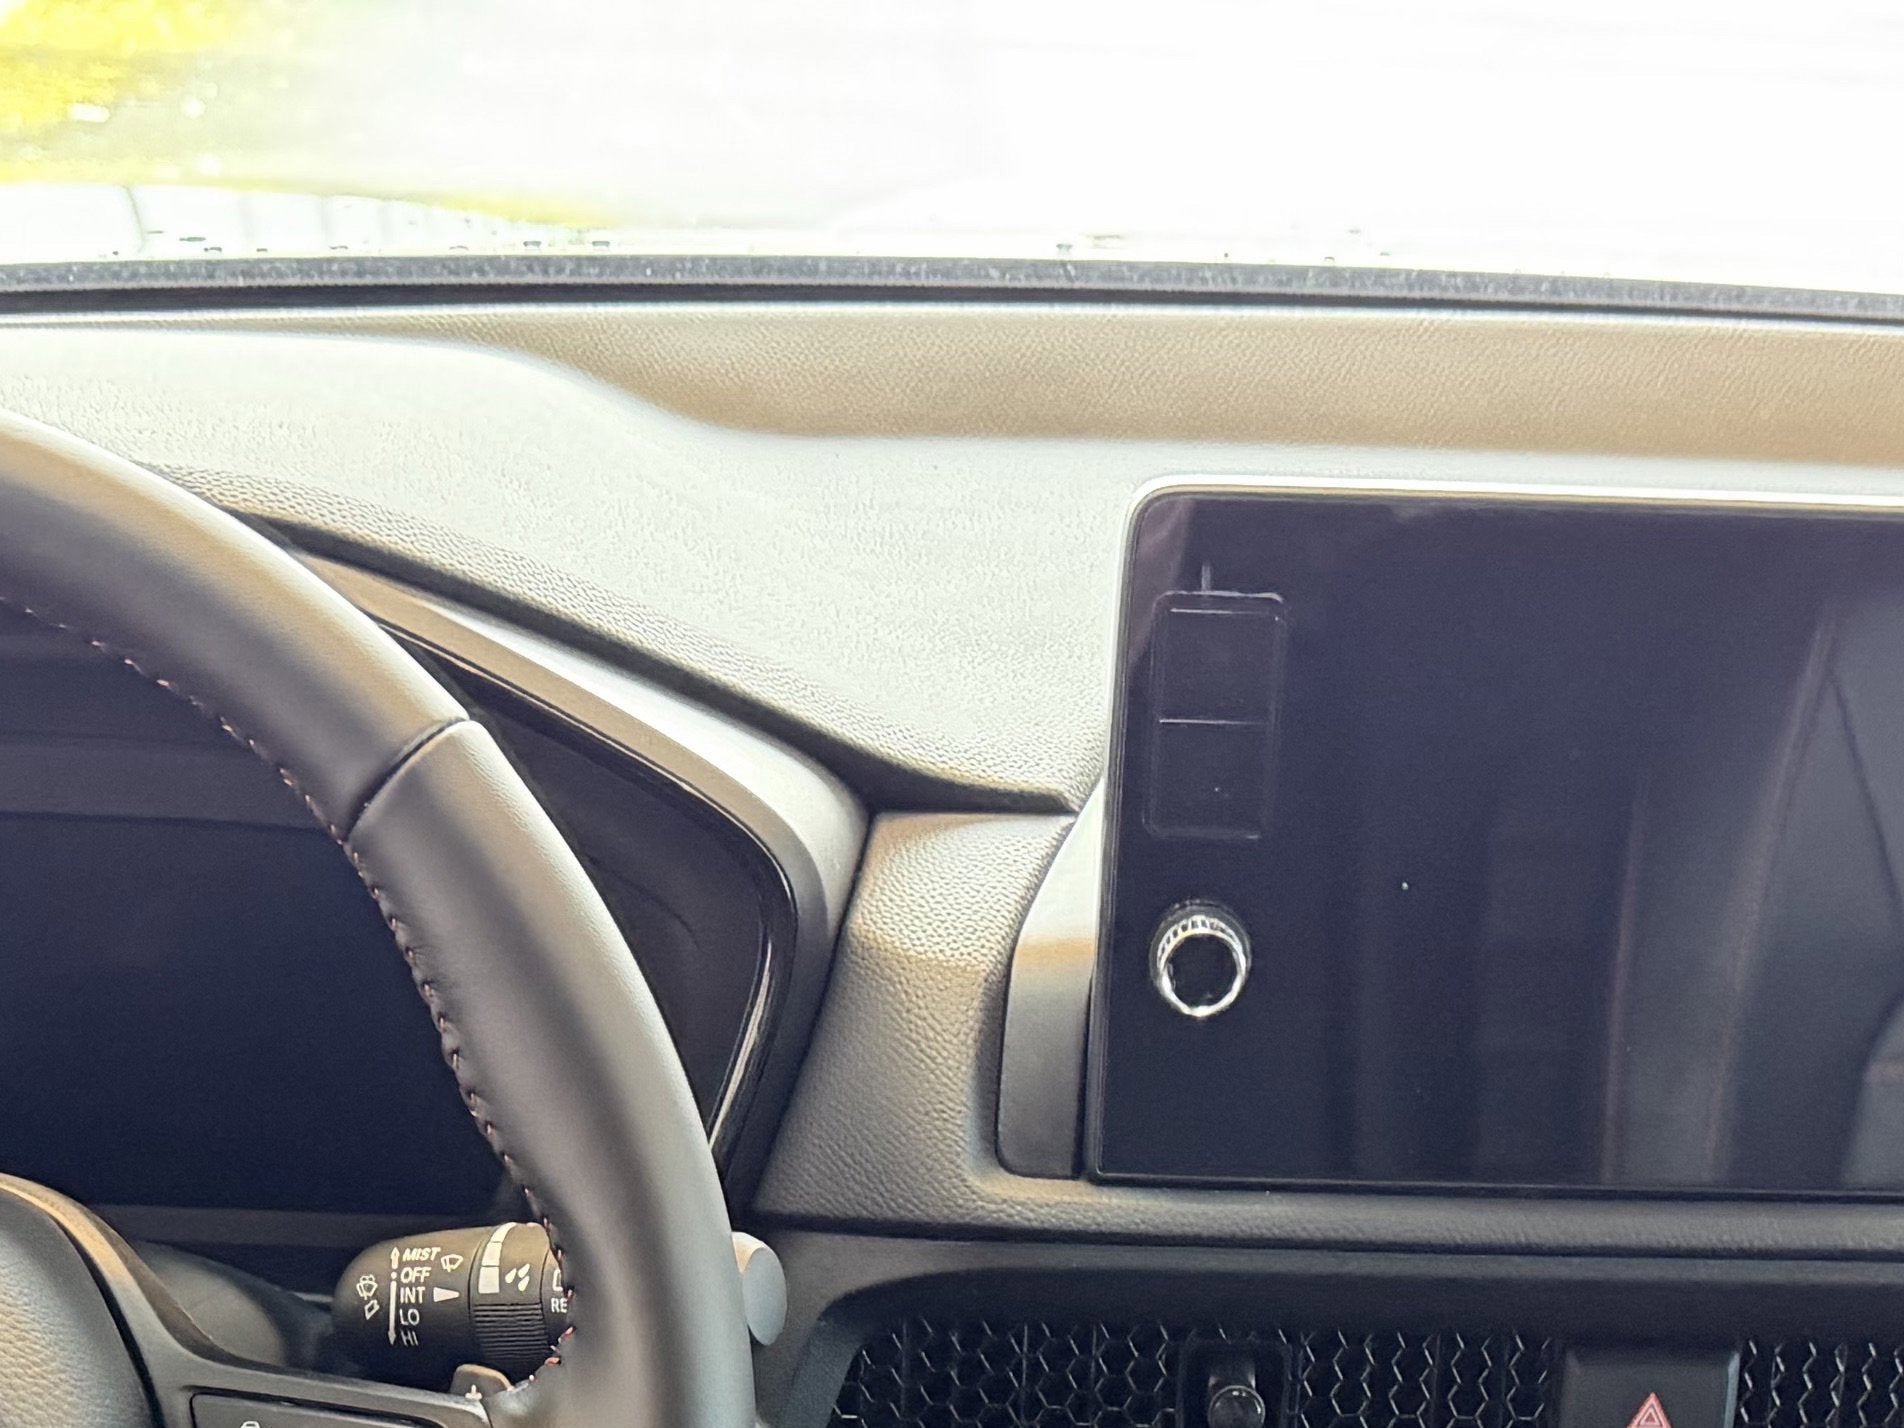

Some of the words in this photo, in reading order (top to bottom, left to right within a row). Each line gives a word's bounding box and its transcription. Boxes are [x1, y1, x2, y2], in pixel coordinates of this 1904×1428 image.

[401, 1246, 441, 1262] MIST
[399, 1266, 432, 1284] OFF
[399, 1286, 426, 1304] INT
[399, 1308, 420, 1326] LO
[399, 1330, 420, 1347] HI
